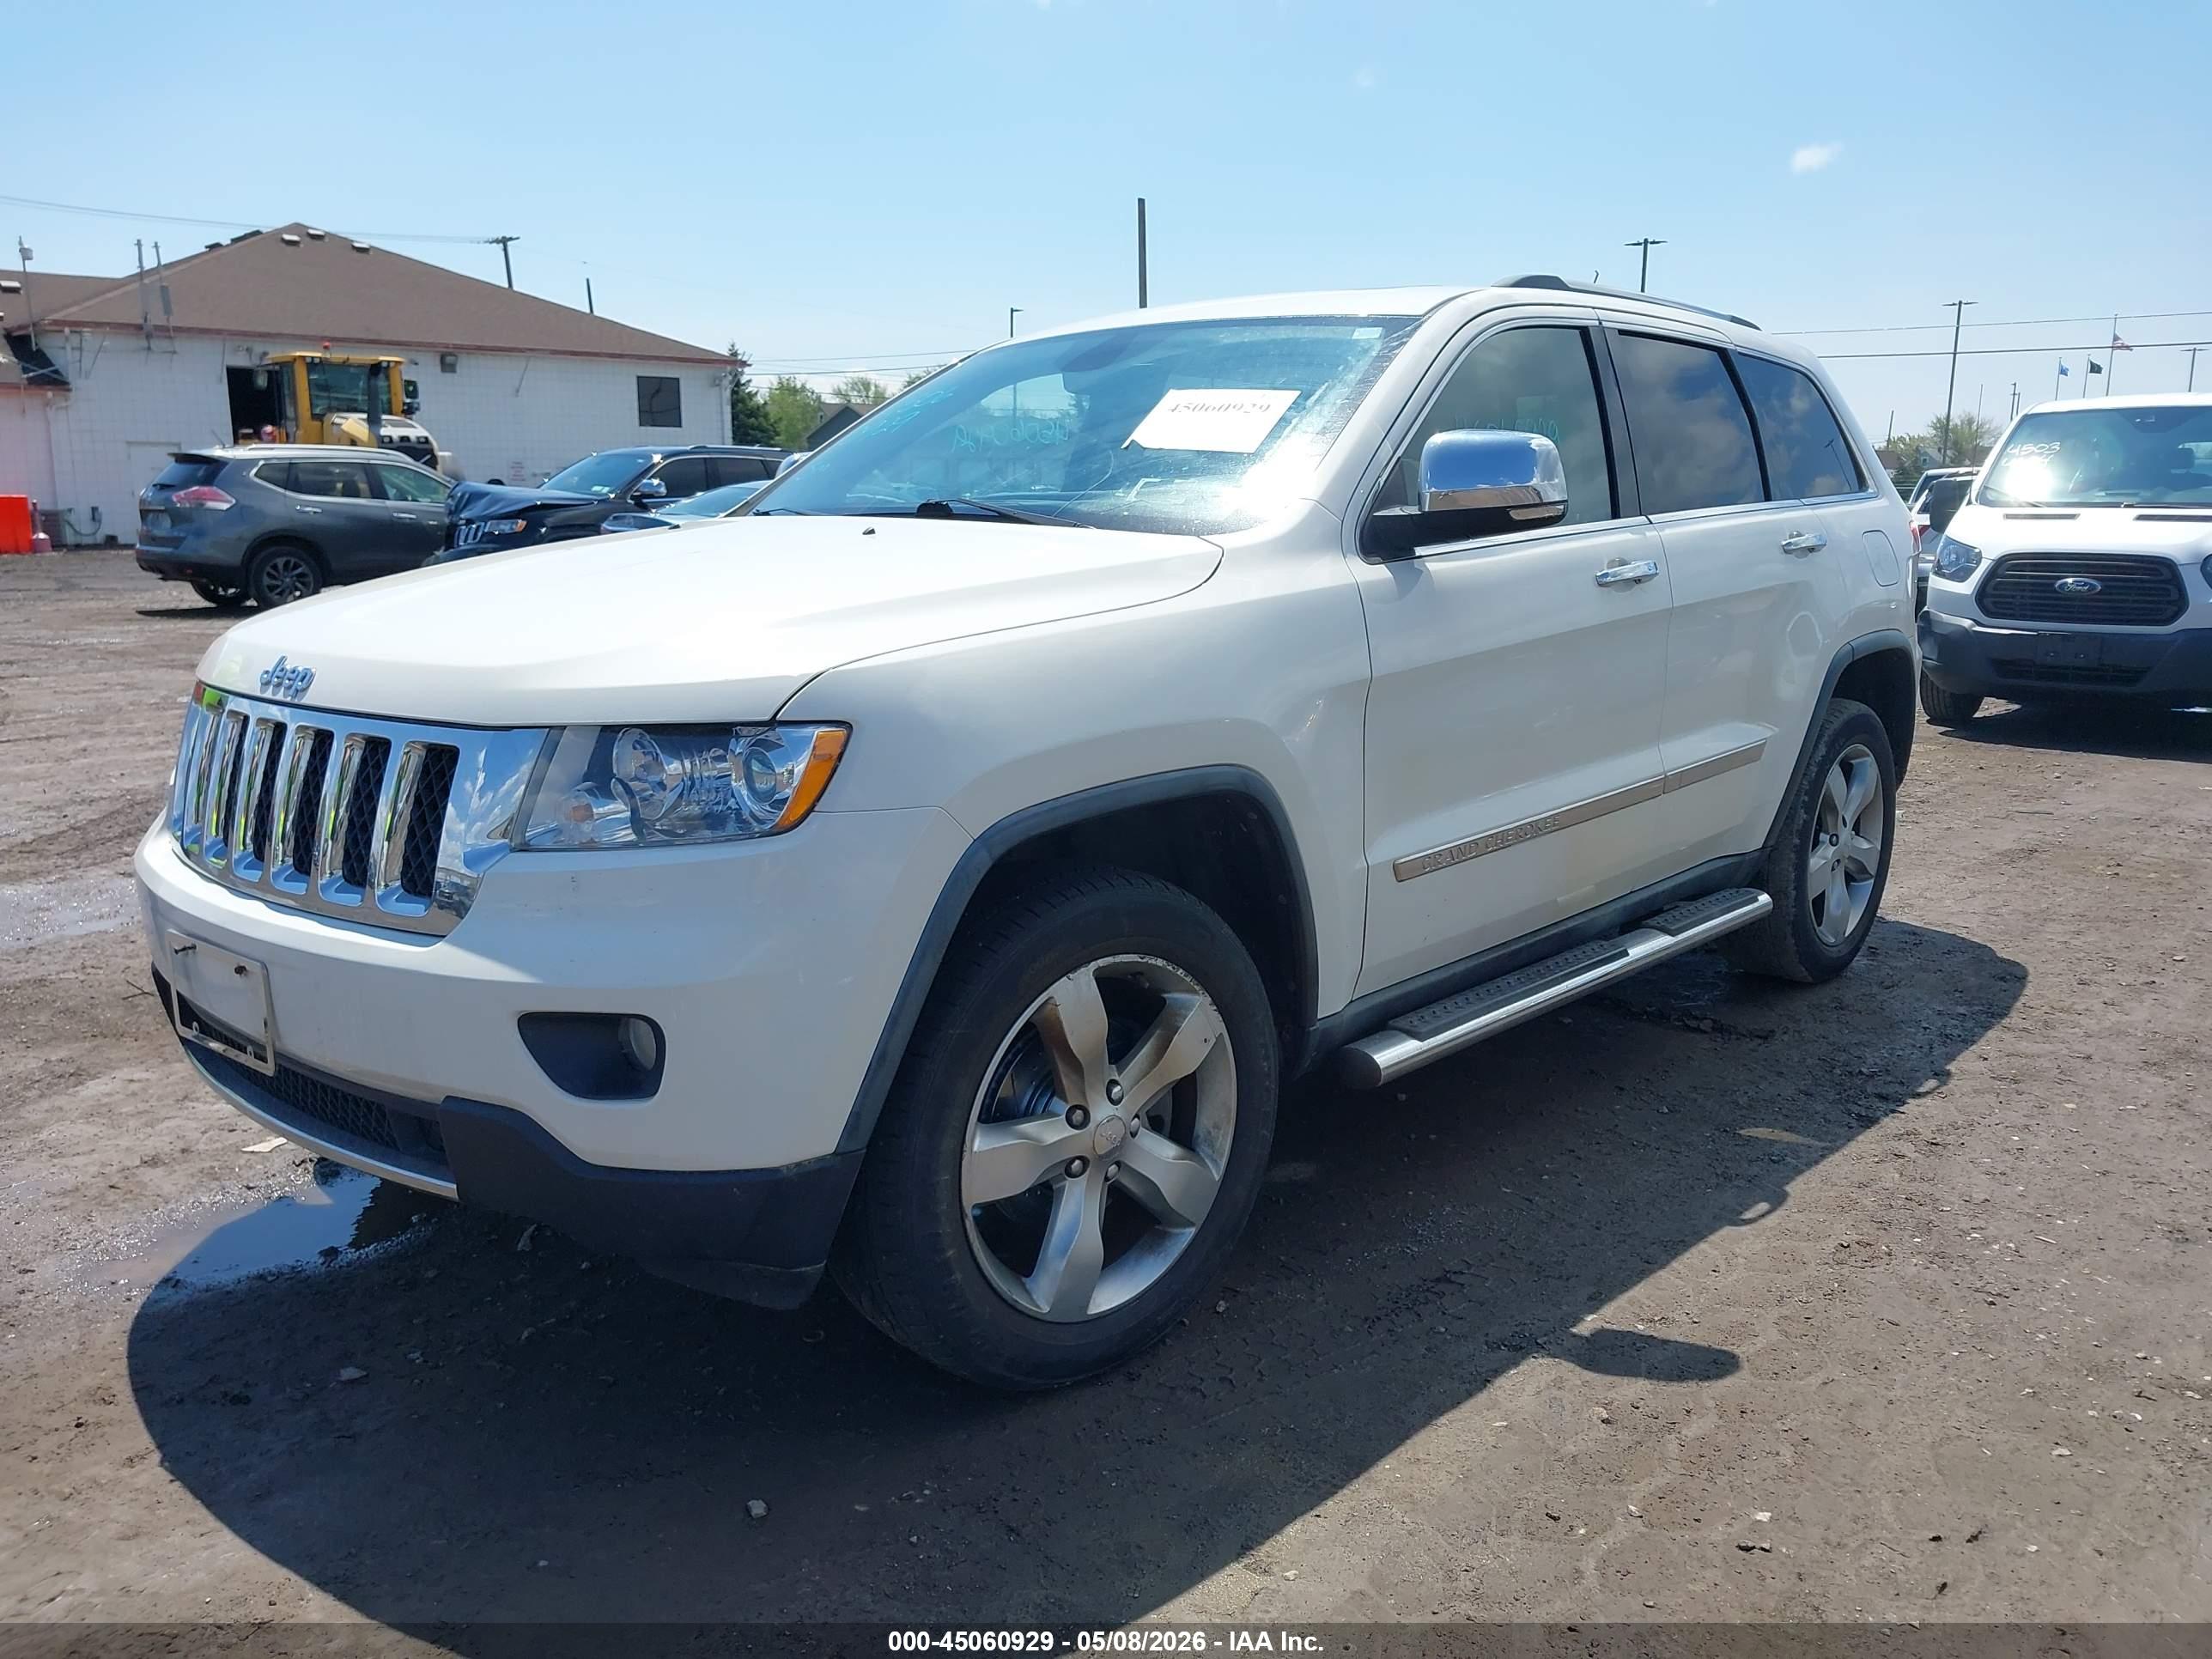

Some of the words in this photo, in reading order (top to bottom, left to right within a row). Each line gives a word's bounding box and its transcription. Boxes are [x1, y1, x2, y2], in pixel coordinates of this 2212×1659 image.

[1168, 401, 1272, 414] 45060929
[2007, 441, 2061, 456] 4503
[260, 655, 316, 702] Jeep
[1422, 842, 1479, 871] GRAND
[1486, 815, 1560, 852] CHEROKEE
